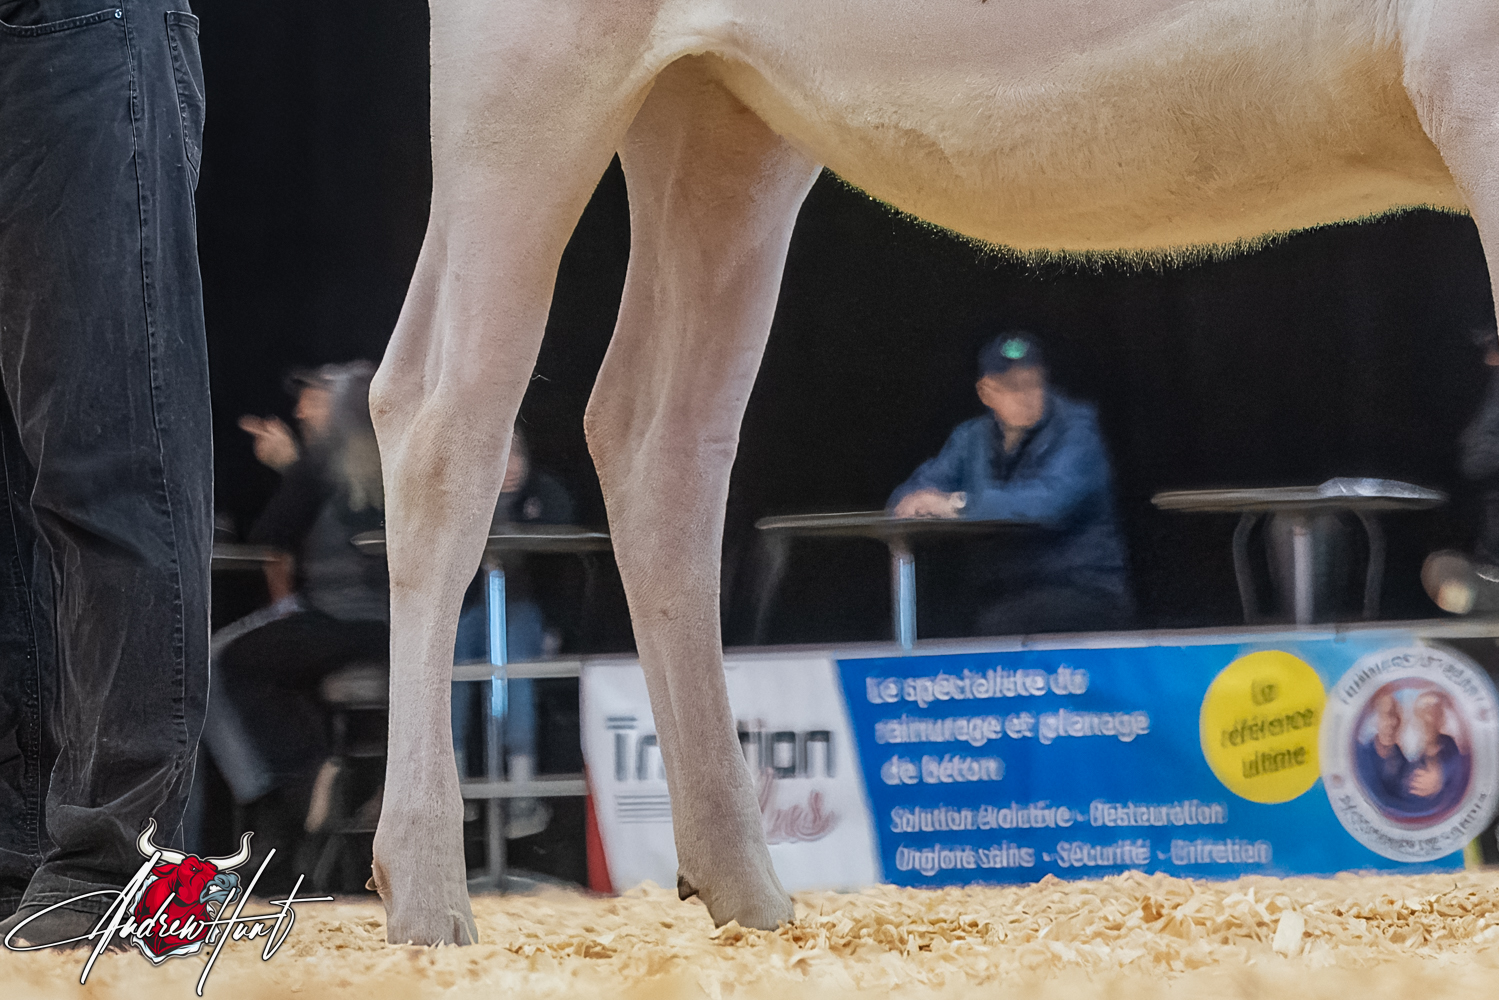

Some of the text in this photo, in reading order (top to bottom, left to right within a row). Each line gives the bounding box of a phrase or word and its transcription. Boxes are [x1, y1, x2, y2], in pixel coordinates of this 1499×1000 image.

[866, 677, 900, 704] Le
[903, 666, 1050, 708] spécialiste
[875, 708, 1150, 747] rainurage et planage
[881, 754, 1005, 785] de béton
[890, 803, 977, 833] Solution
